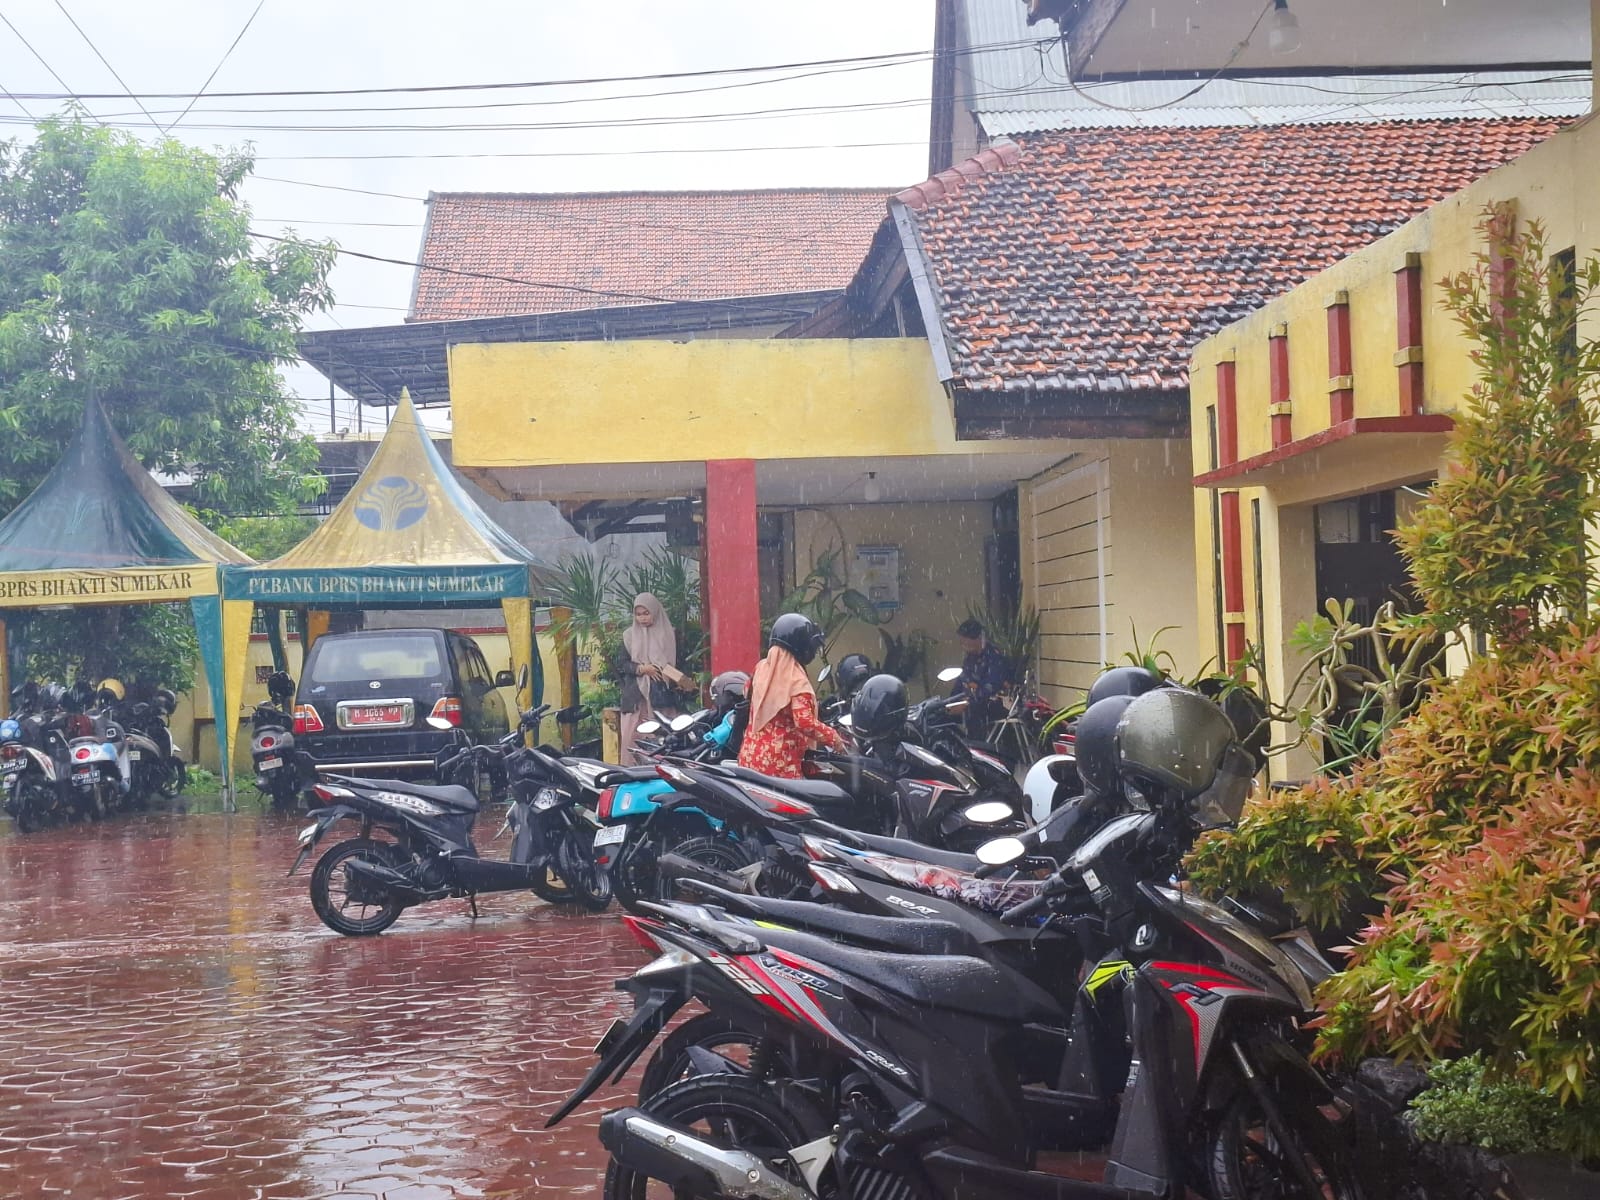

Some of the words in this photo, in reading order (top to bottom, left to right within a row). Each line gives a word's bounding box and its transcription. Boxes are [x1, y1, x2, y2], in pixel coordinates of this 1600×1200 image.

[42, 576, 106, 596] BHAKTI
[111, 571, 192, 593] SUMEKAR
[248, 577, 314, 594] PT.BANK
[319, 576, 359, 593] BPRS
[362, 576, 423, 592] BHAKTI
[427, 575, 504, 592] SUMEKAR
